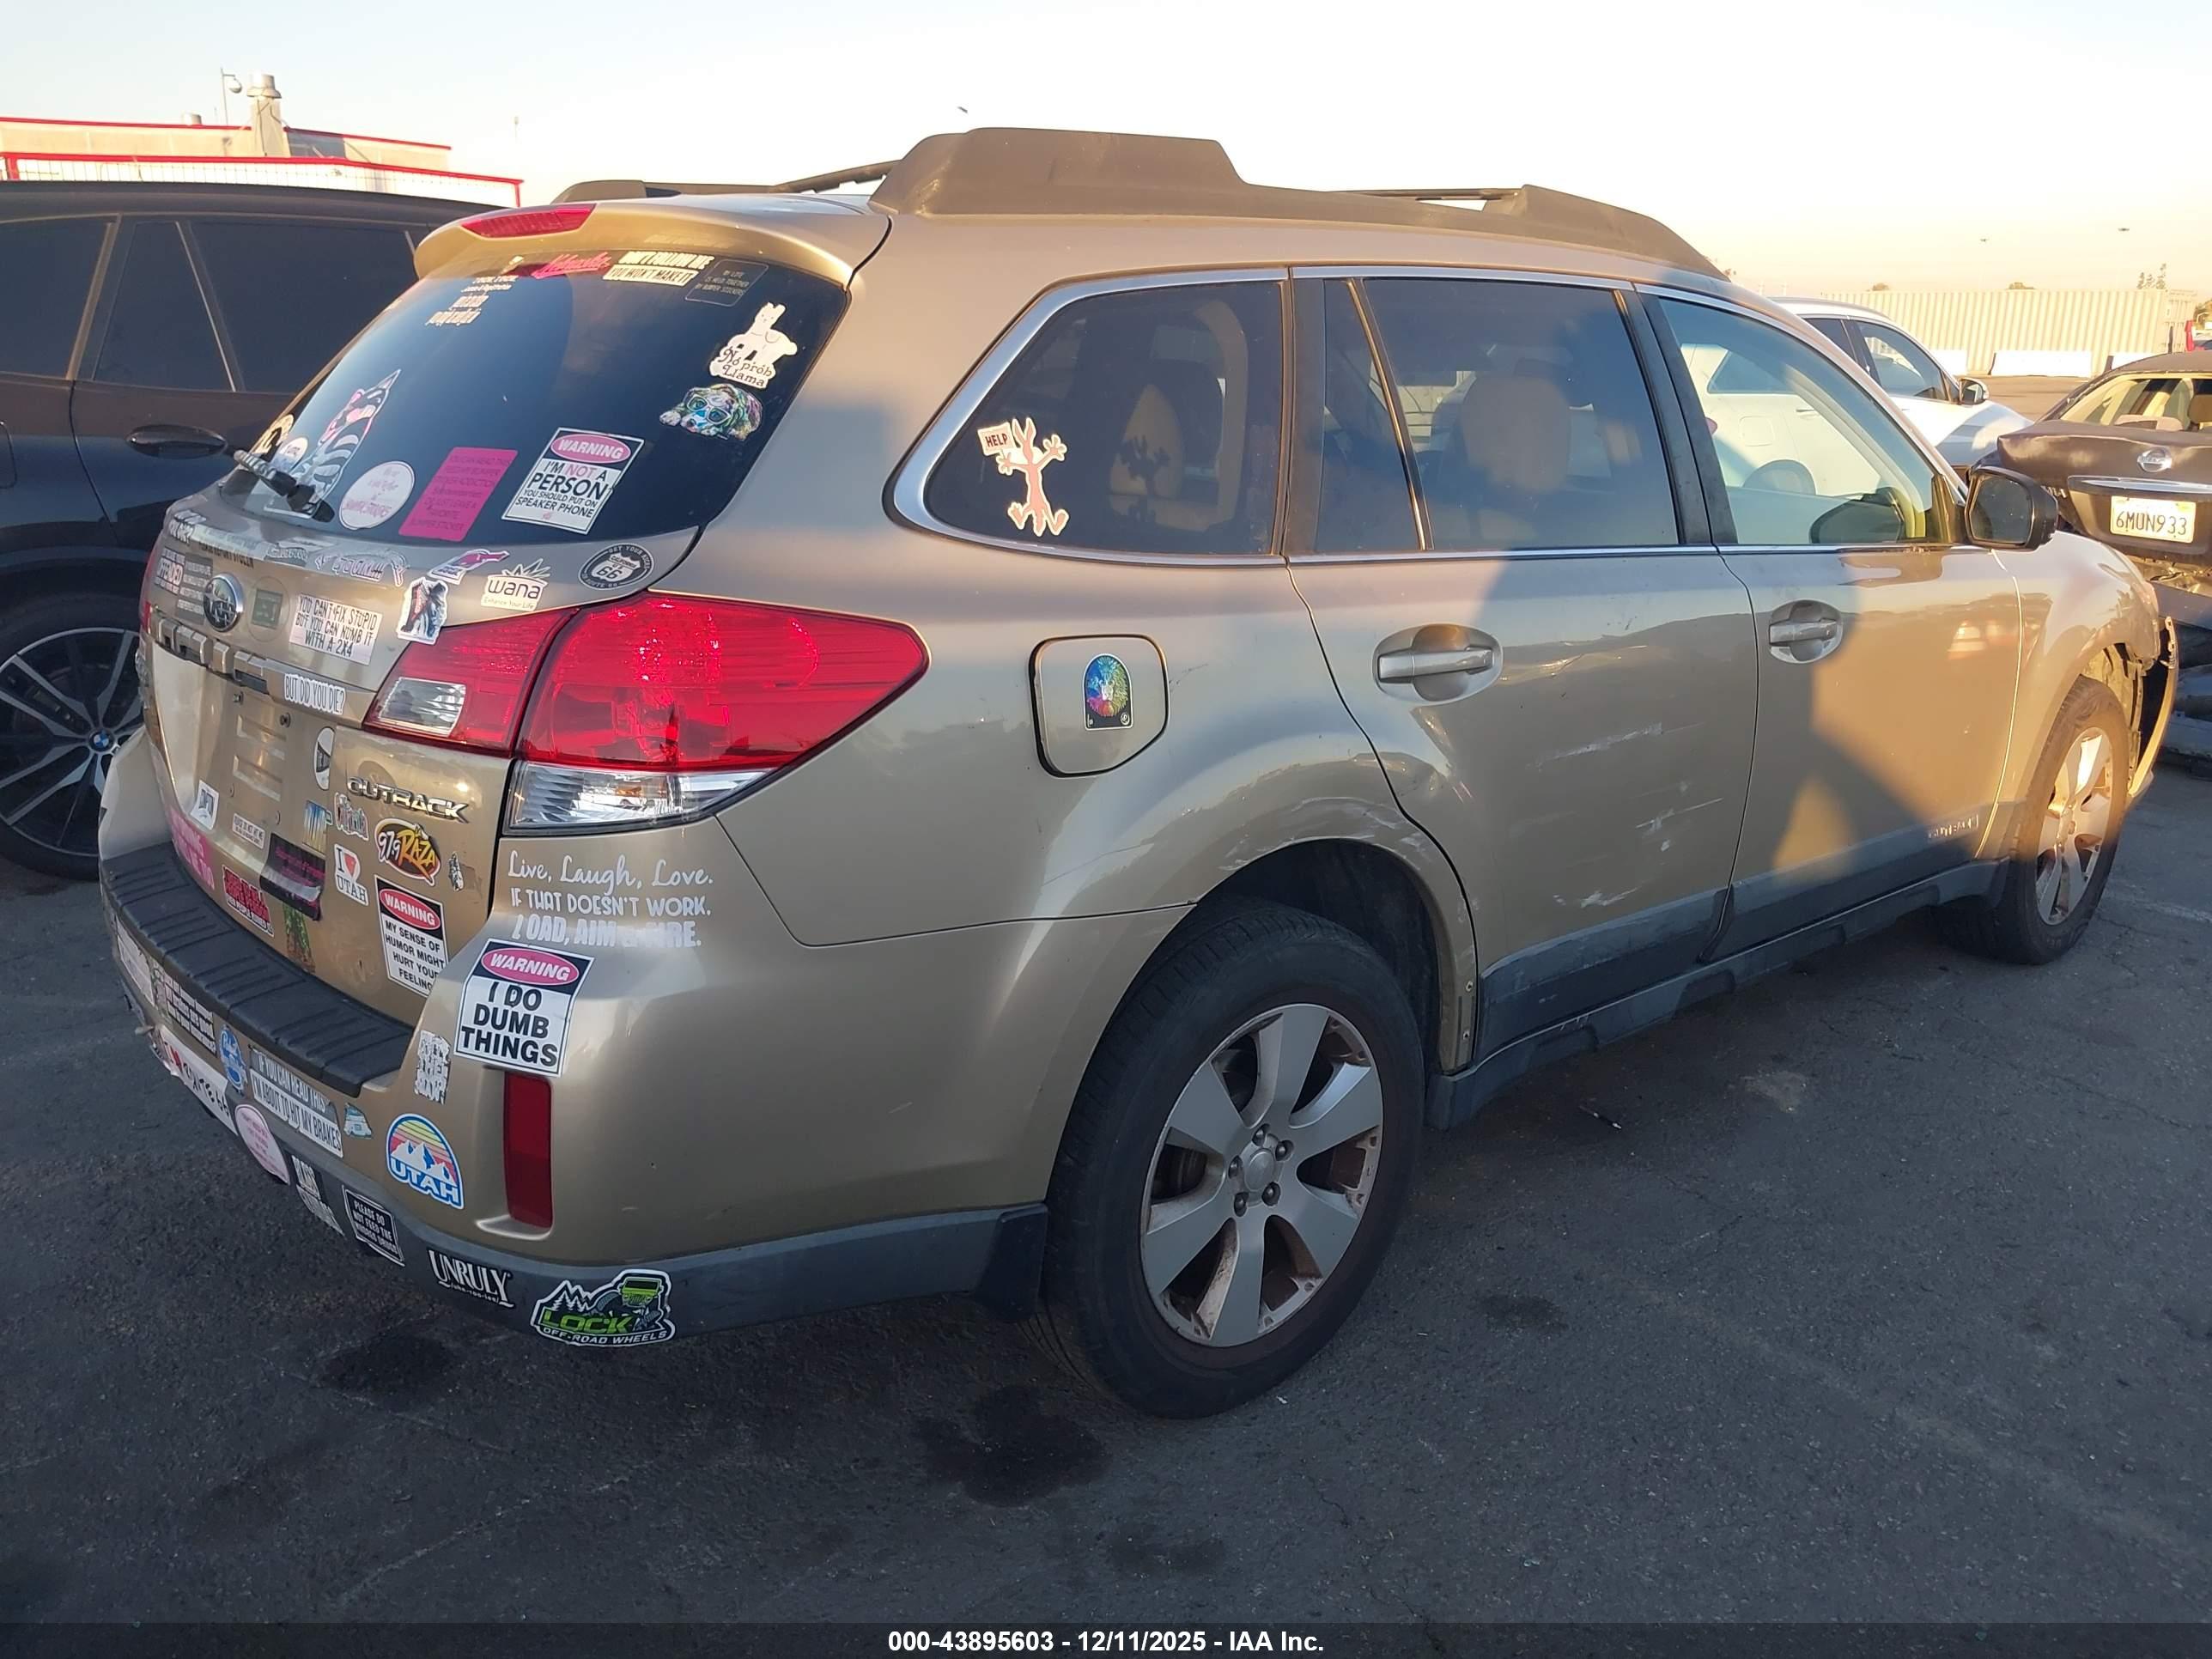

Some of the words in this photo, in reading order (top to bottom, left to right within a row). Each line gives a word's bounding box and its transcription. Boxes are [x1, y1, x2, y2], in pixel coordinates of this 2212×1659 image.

[606, 267, 628, 278] YOU
[655, 270, 681, 282] MAKE
[718, 345, 741, 366] No
[738, 362, 772, 377] prob
[721, 364, 765, 387] Llama
[557, 439, 624, 459] WARNING
[984, 433, 1009, 447] HELP
[527, 472, 608, 500] PERSON
[543, 461, 565, 474] I'M
[565, 464, 597, 478] NOT
[595, 470, 608, 482] A
[515, 496, 558, 512] SPEAKER
[557, 502, 595, 518] PHONE
[524, 489, 538, 498] YOU
[538, 490, 568, 502] SHOULD
[568, 495, 586, 505] PUT
[584, 499, 599, 508] ON
[2115, 510, 2188, 537] 6MUN933
[626, 545, 643, 556] YOUR
[597, 565, 623, 579] 66
[483, 597, 507, 605] Enhance
[488, 579, 541, 599] wana
[299, 595, 313, 614] YOU
[313, 599, 334, 619] CAN'T
[334, 605, 349, 623] FIX
[348, 609, 378, 630] STUPID
[295, 612, 310, 628] BUT
[309, 616, 324, 633] YOU
[325, 620, 341, 636] CAN
[363, 630, 374, 646] IT
[305, 629, 325, 649] WITH
[326, 636, 333, 652] A
[335, 640, 354, 658] 2X4
[285, 675, 298, 700] BUT
[300, 678, 312, 705] DID
[312, 681, 328, 708] YOU
[328, 686, 346, 714] DIE?
[337, 848, 345, 872] I
[378, 830, 401, 861] 97.9
[398, 829, 437, 878] RAZA
[336, 872, 368, 902] UTAH
[507, 850, 552, 884] Live,
[559, 854, 643, 896] Laugh,
[652, 859, 714, 887] Love.
[383, 891, 436, 927] WARNING
[510, 887, 523, 908] IF
[526, 889, 562, 913] THAT
[567, 893, 640, 917] DOESN'T
[645, 896, 712, 917] WORK.
[385, 920, 398, 934] MY
[398, 927, 427, 948] SENSE
[428, 940, 441, 953] OF
[574, 918, 618, 947] AIM
[384, 933, 415, 956] HUMOR
[416, 949, 446, 970] MIGHT
[392, 951, 415, 970] HURT
[490, 952, 571, 981] WARNING
[488, 981, 501, 1004] I
[503, 984, 543, 1012] DO
[473, 1002, 550, 1039] DUMB
[460, 1024, 558, 1067] THINGS
[264, 1056, 277, 1082] YOU
[276, 1065, 291, 1092] CAN
[290, 1074, 309, 1103] READ
[309, 1085, 326, 1113] THIS
[262, 1081, 280, 1112] ABOUT
[278, 1094, 290, 1120] TO
[289, 1099, 300, 1127] HIT
[300, 1107, 313, 1133] MY
[312, 1115, 342, 1151] BRAKES
[390, 1156, 460, 1205] UTAH
[352, 1209, 364, 1224] NOT
[364, 1217, 380, 1234] FEED
[380, 1226, 393, 1242] THE
[354, 1199, 376, 1221] PLEASE
[375, 1212, 386, 1226] DO
[428, 1249, 512, 1304] UNRULY
[542, 1308, 634, 1335] LOCK
[544, 1327, 610, 1345] OFF-ROAD
[612, 1331, 668, 1345] WHEELS
